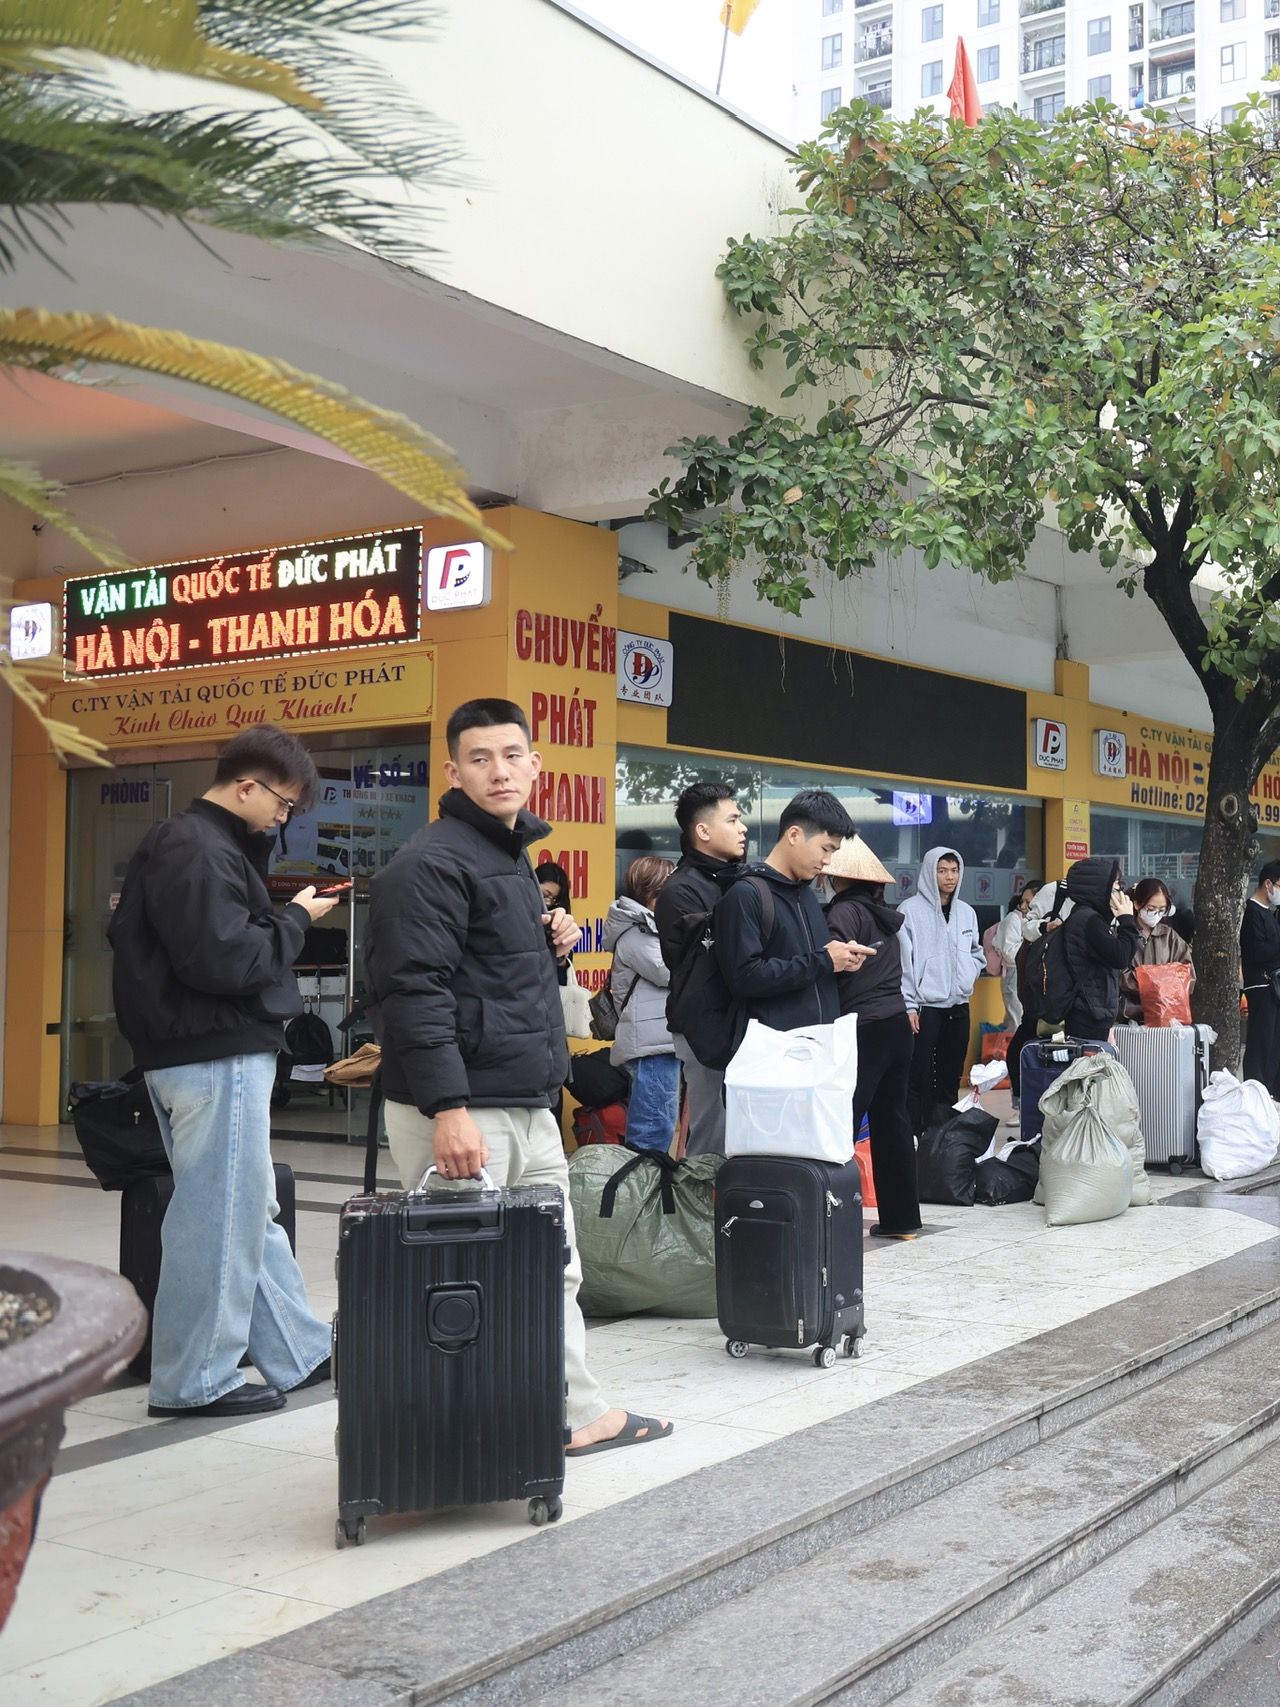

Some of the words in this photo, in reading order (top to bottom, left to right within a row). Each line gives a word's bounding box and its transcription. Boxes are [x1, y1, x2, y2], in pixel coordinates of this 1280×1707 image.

[81, 579, 126, 620] VẬN
[131, 569, 167, 609] TẢI
[172, 559, 241, 604] QUỐC
[246, 551, 277, 592] TẾ
[278, 550, 328, 588] ĐỨC
[334, 539, 402, 581] PHÁT
[75, 624, 117, 672] HÀ
[122, 618, 181, 671] NỘI
[207, 605, 321, 656] THANH
[328, 588, 407, 642] HÓA
[515, 603, 616, 674] CHUYỂN
[72, 695, 111, 714] C.TY
[116, 688, 154, 711] VẬN
[160, 683, 191, 705] TẢI
[197, 676, 254, 703] QUỐC
[260, 672, 287, 695] TẾ
[293, 669, 338, 691] ĐỨC
[345, 663, 405, 687] PHÁT
[109, 712, 161, 737] Kính
[168, 709, 218, 732] Chào
[272, 693, 358, 721] Khách!
[530, 687, 597, 748] PHÁT
[1140, 727, 1162, 742] C.TY
[1164, 731, 1185, 749] VẬN
[353, 760, 374, 789] VÉ
[379, 754, 402, 788] SỐ
[407, 761, 428, 786] 19
[1126, 742, 1151, 778] HÀ
[1158, 750, 1190, 790] NỘI
[100, 778, 150, 805] PHÒNG
[1131, 782, 1183, 810] Hotline:
